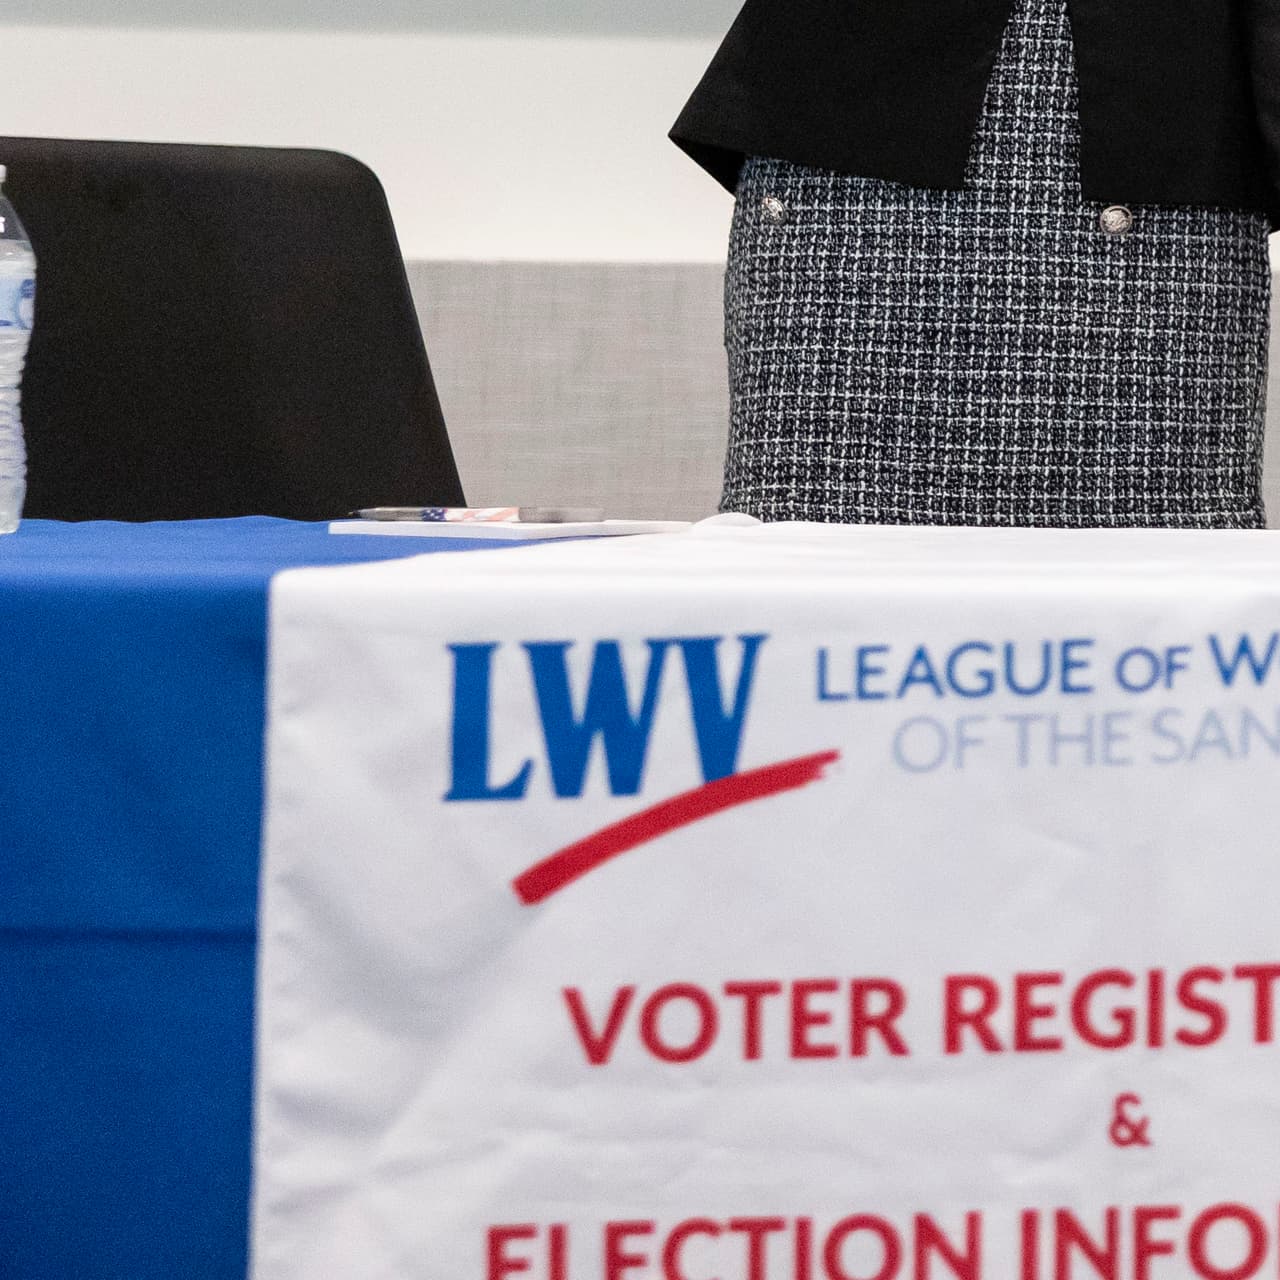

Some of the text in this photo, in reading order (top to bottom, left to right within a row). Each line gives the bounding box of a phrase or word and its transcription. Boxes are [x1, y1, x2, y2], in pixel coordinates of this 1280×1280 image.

[815, 637, 1096, 704] LEAGUE
[1113, 644, 1191, 695] OF
[441, 632, 770, 803] LWV
[892, 715, 987, 774] OF
[1004, 710, 1133, 768] THE
[564, 978, 909, 1066] VOTER
[1108, 1092, 1150, 1148] &
[486, 1209, 983, 1280] ELECTION
